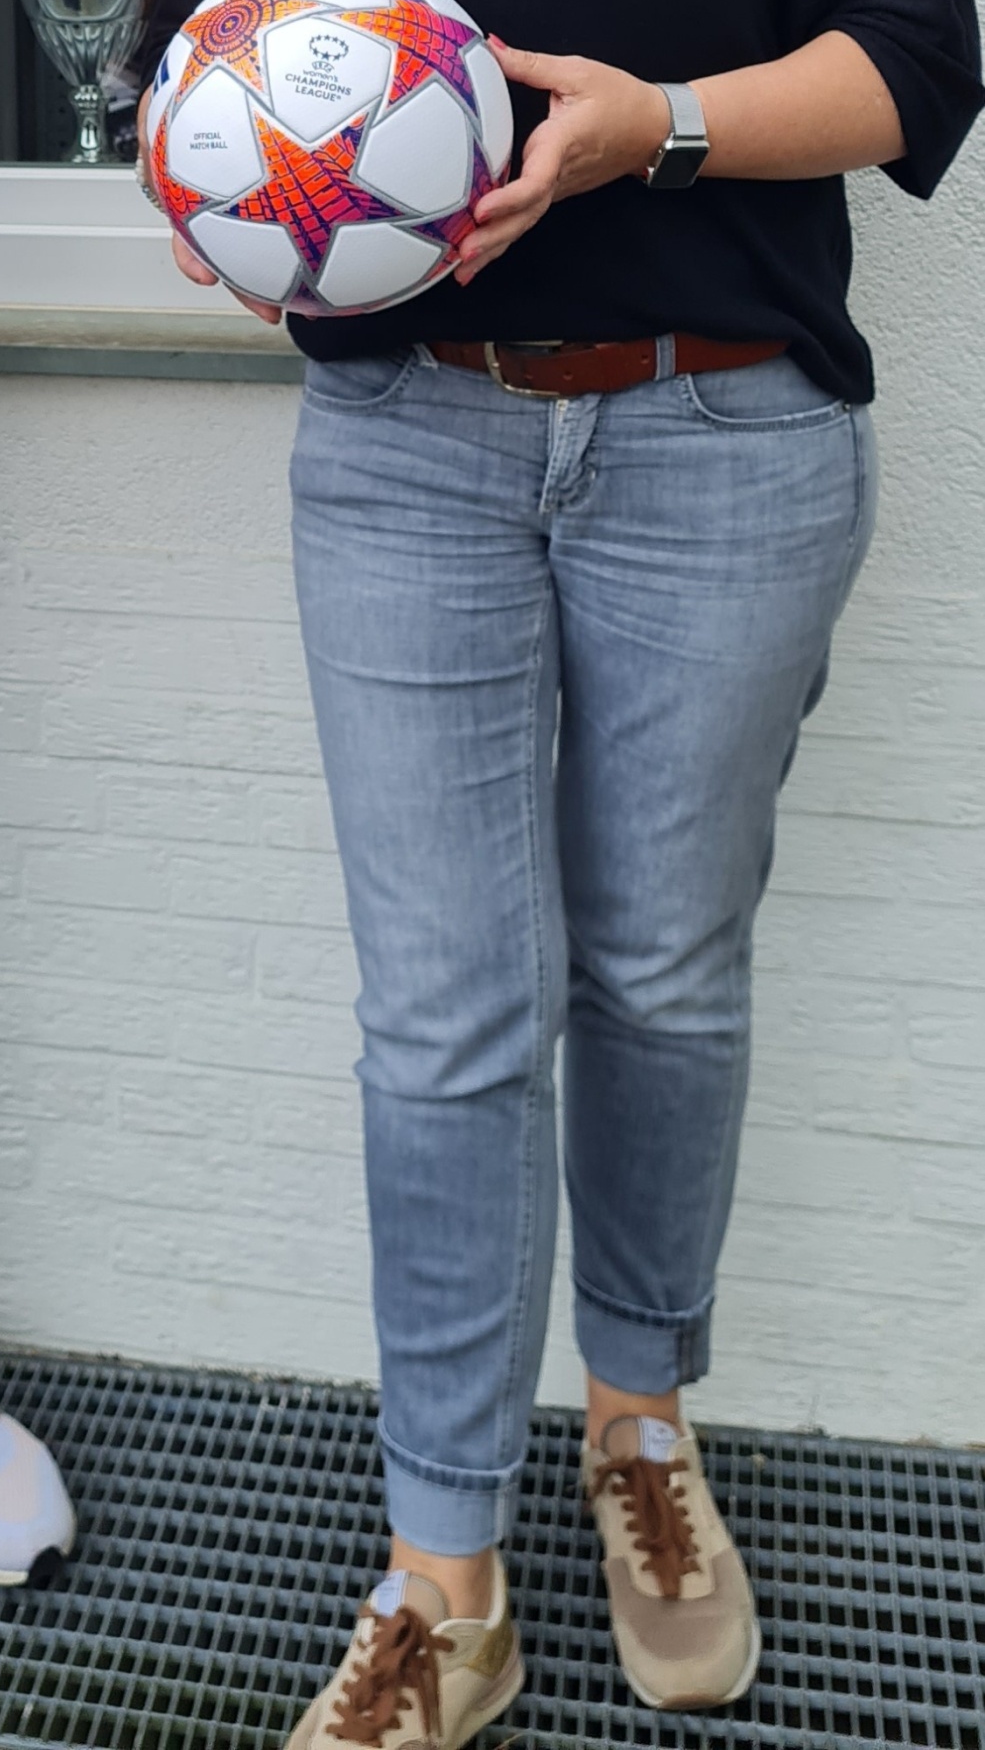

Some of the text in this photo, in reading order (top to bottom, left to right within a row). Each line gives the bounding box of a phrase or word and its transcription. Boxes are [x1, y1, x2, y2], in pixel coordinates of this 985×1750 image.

[284, 73, 352, 96] CHAMPIONS
[193, 131, 222, 141] OFFICIAL
[189, 140, 228, 150] MATCH BALL
